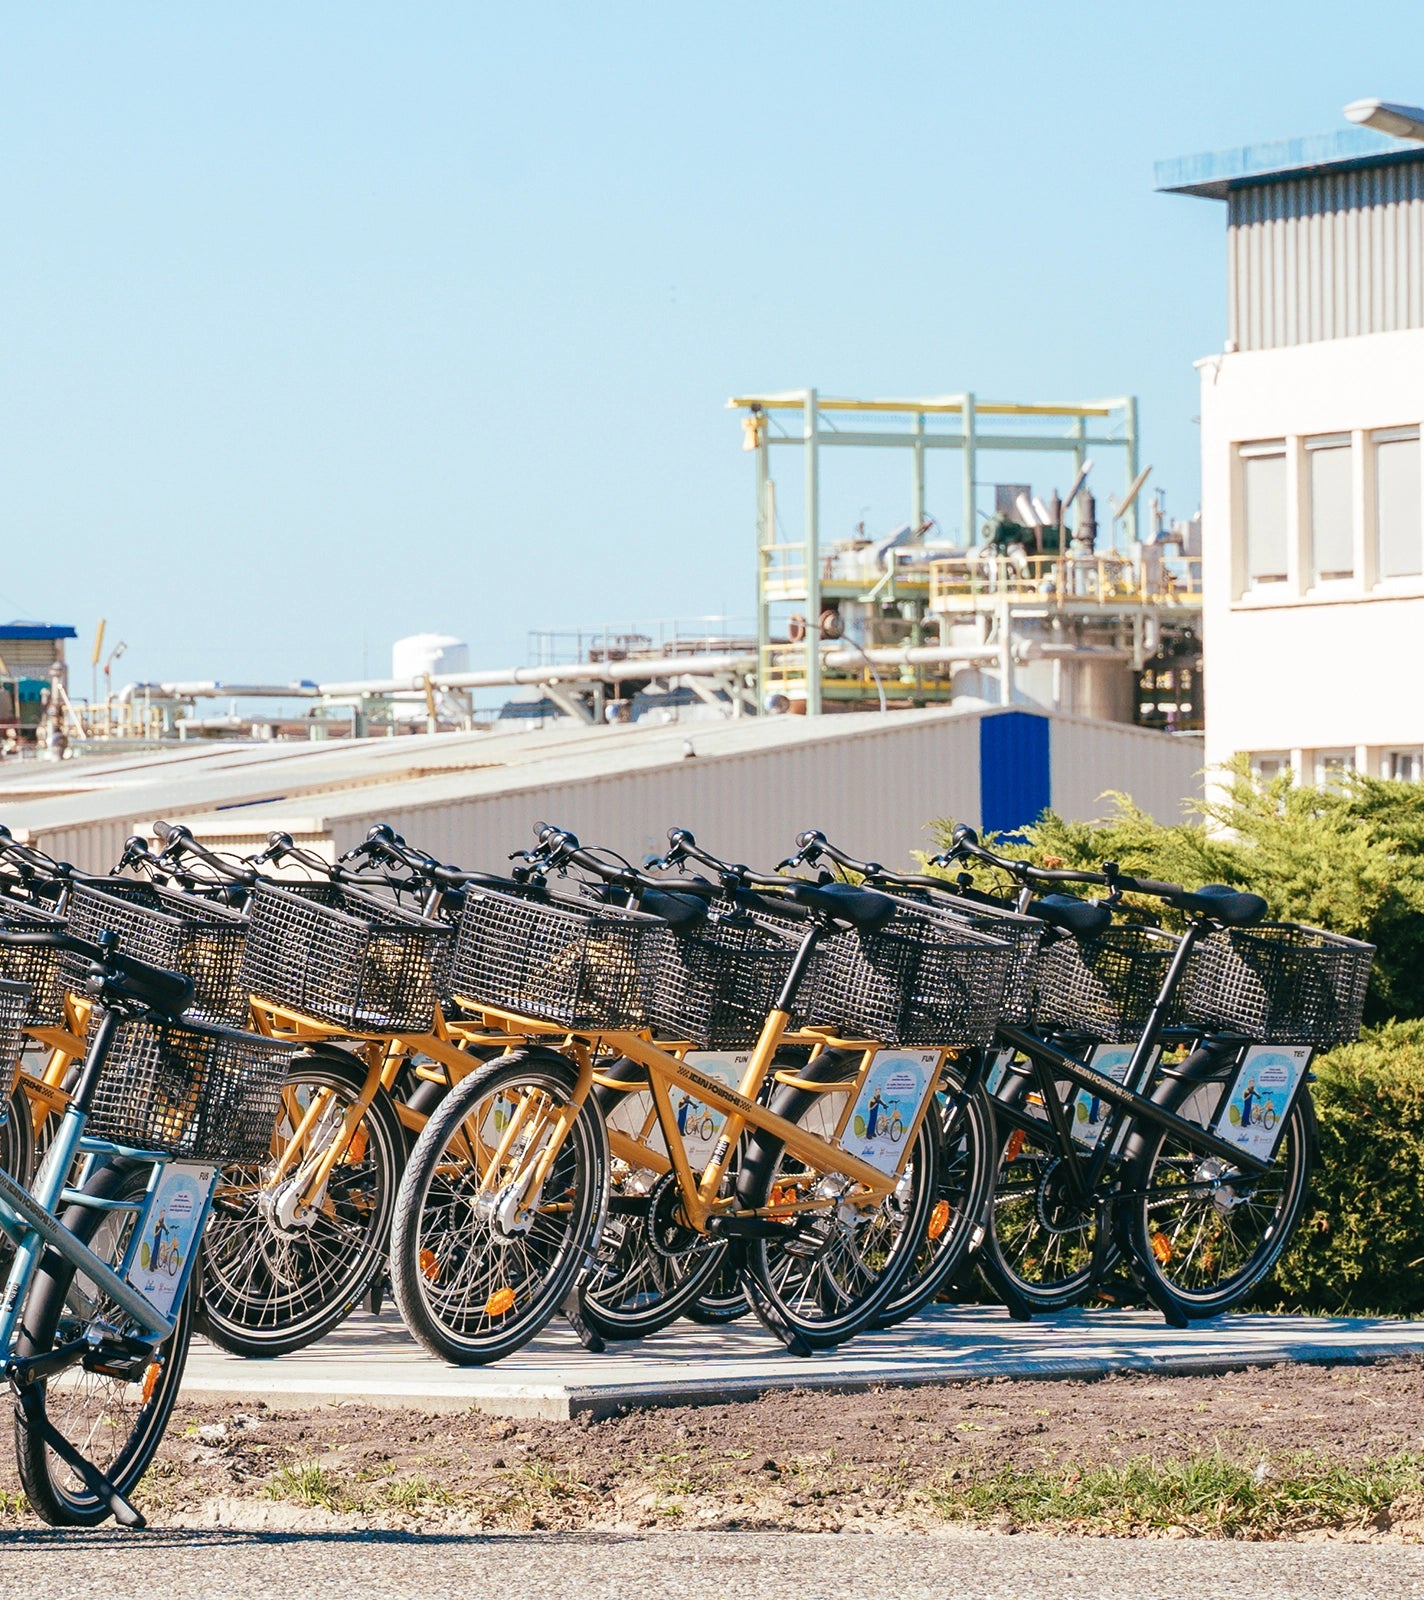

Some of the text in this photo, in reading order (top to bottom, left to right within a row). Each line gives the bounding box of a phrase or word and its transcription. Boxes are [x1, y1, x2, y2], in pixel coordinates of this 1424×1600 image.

[734, 1055, 748, 1063] FUN
[921, 1055, 935, 1063] FUN
[198, 1172, 209, 1180] FUS
